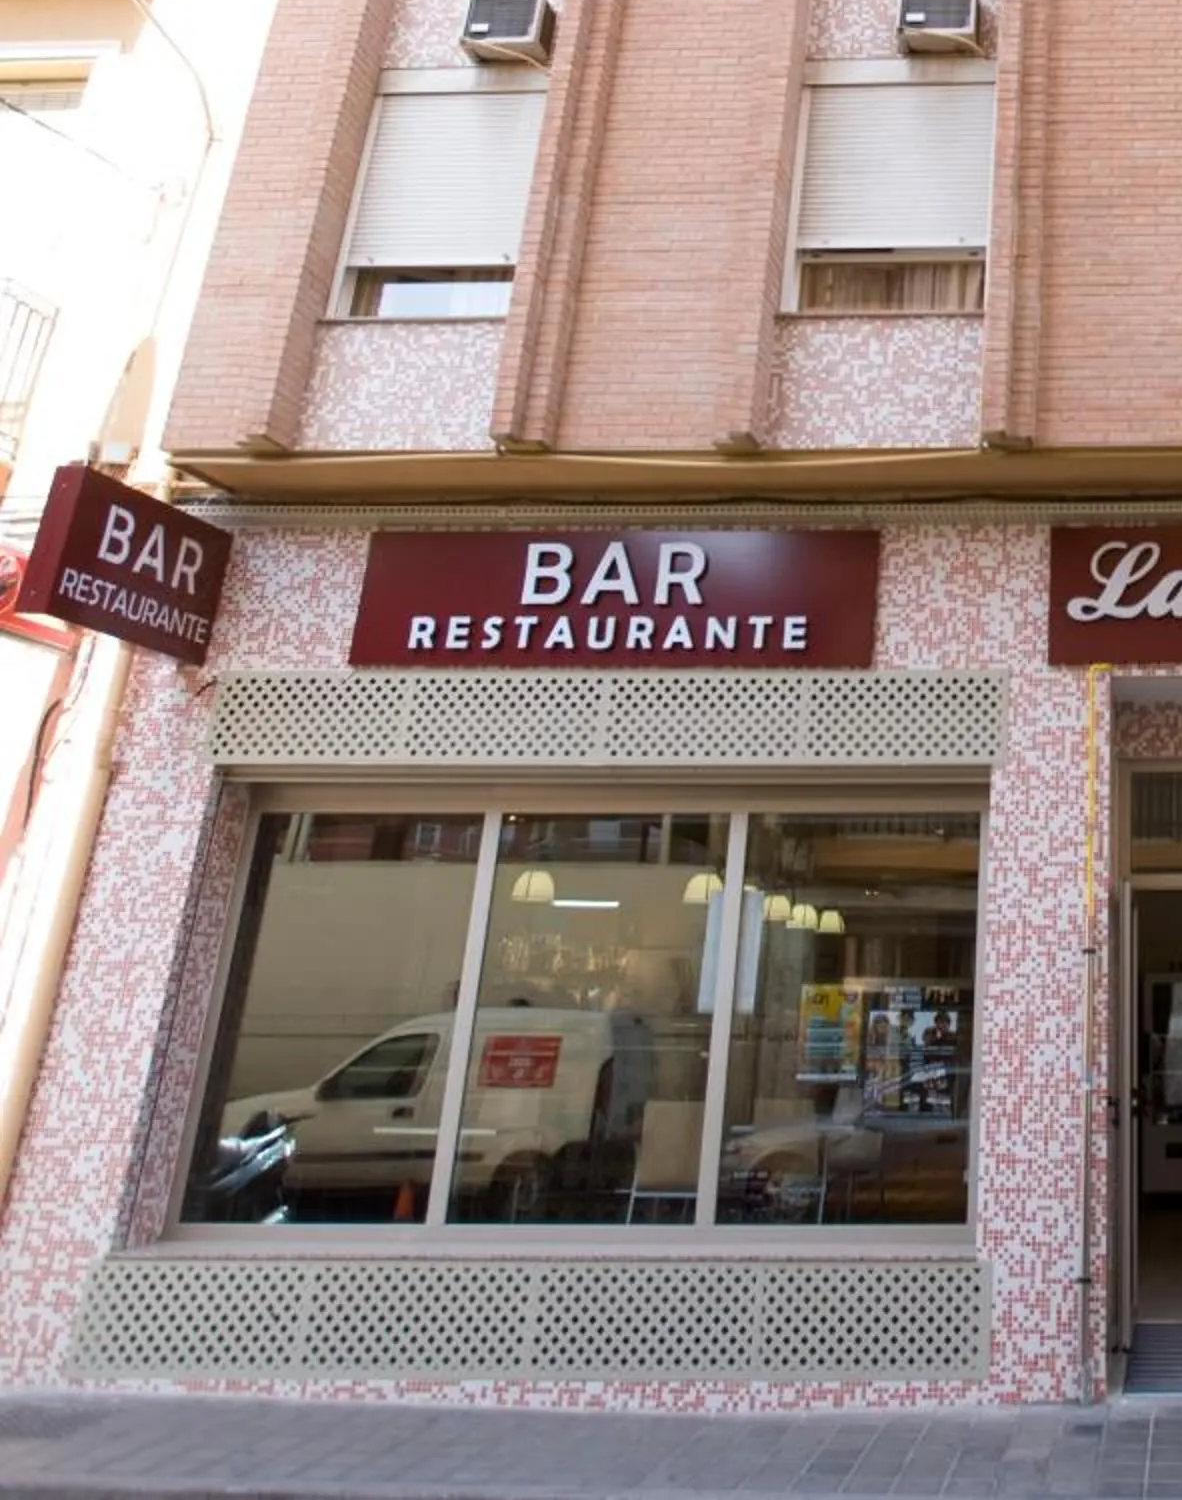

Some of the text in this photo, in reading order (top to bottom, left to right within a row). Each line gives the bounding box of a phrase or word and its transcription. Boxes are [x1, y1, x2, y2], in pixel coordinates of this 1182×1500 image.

[97, 504, 203, 595] BAR
[519, 540, 708, 606] BAR
[58, 566, 209, 645] RESTAURANTE
[407, 614, 808, 650] RESTAURANTE
